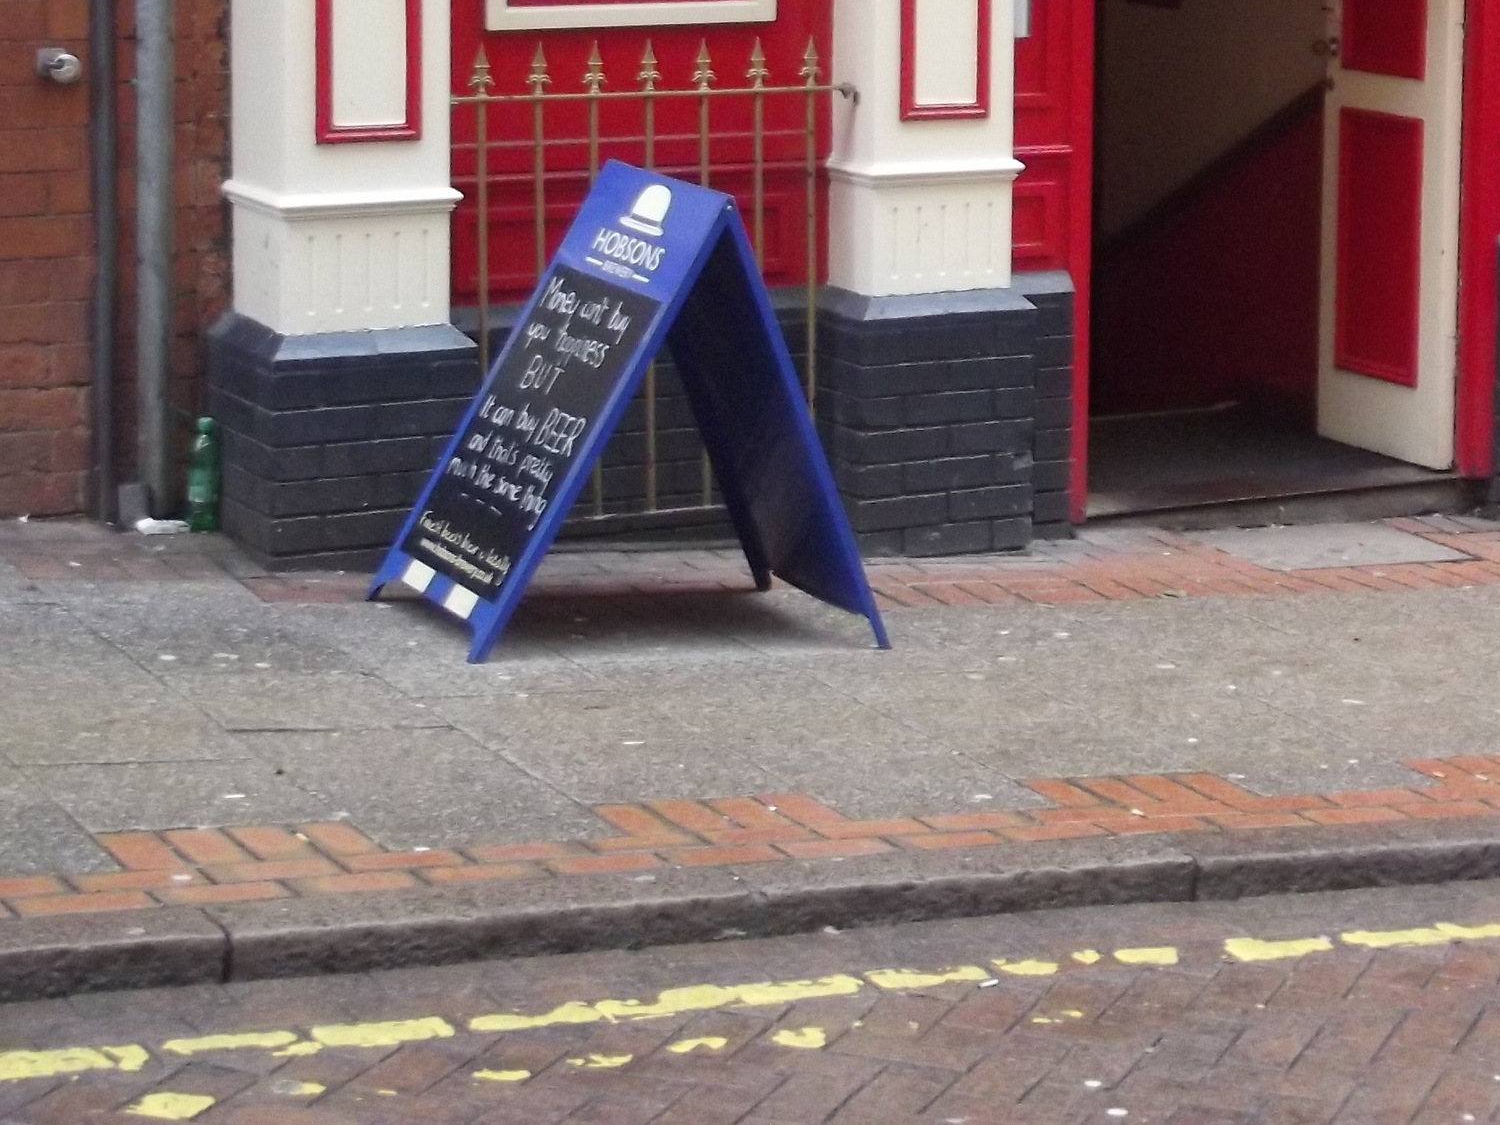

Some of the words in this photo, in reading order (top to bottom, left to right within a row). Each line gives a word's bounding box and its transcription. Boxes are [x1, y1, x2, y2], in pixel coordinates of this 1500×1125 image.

[591, 227, 667, 272] HOBSONS
[539, 276, 582, 327] Money
[607, 301, 632, 345] buy
[526, 321, 552, 351] you
[519, 354, 565, 395] BUT
[466, 430, 494, 453] and
[479, 394, 498, 419] It
[490, 406, 516, 427] can
[515, 402, 541, 443] buy
[533, 406, 588, 458] BEER
[474, 464, 496, 489] the
[492, 476, 524, 502] same
[519, 484, 549, 532] thing
